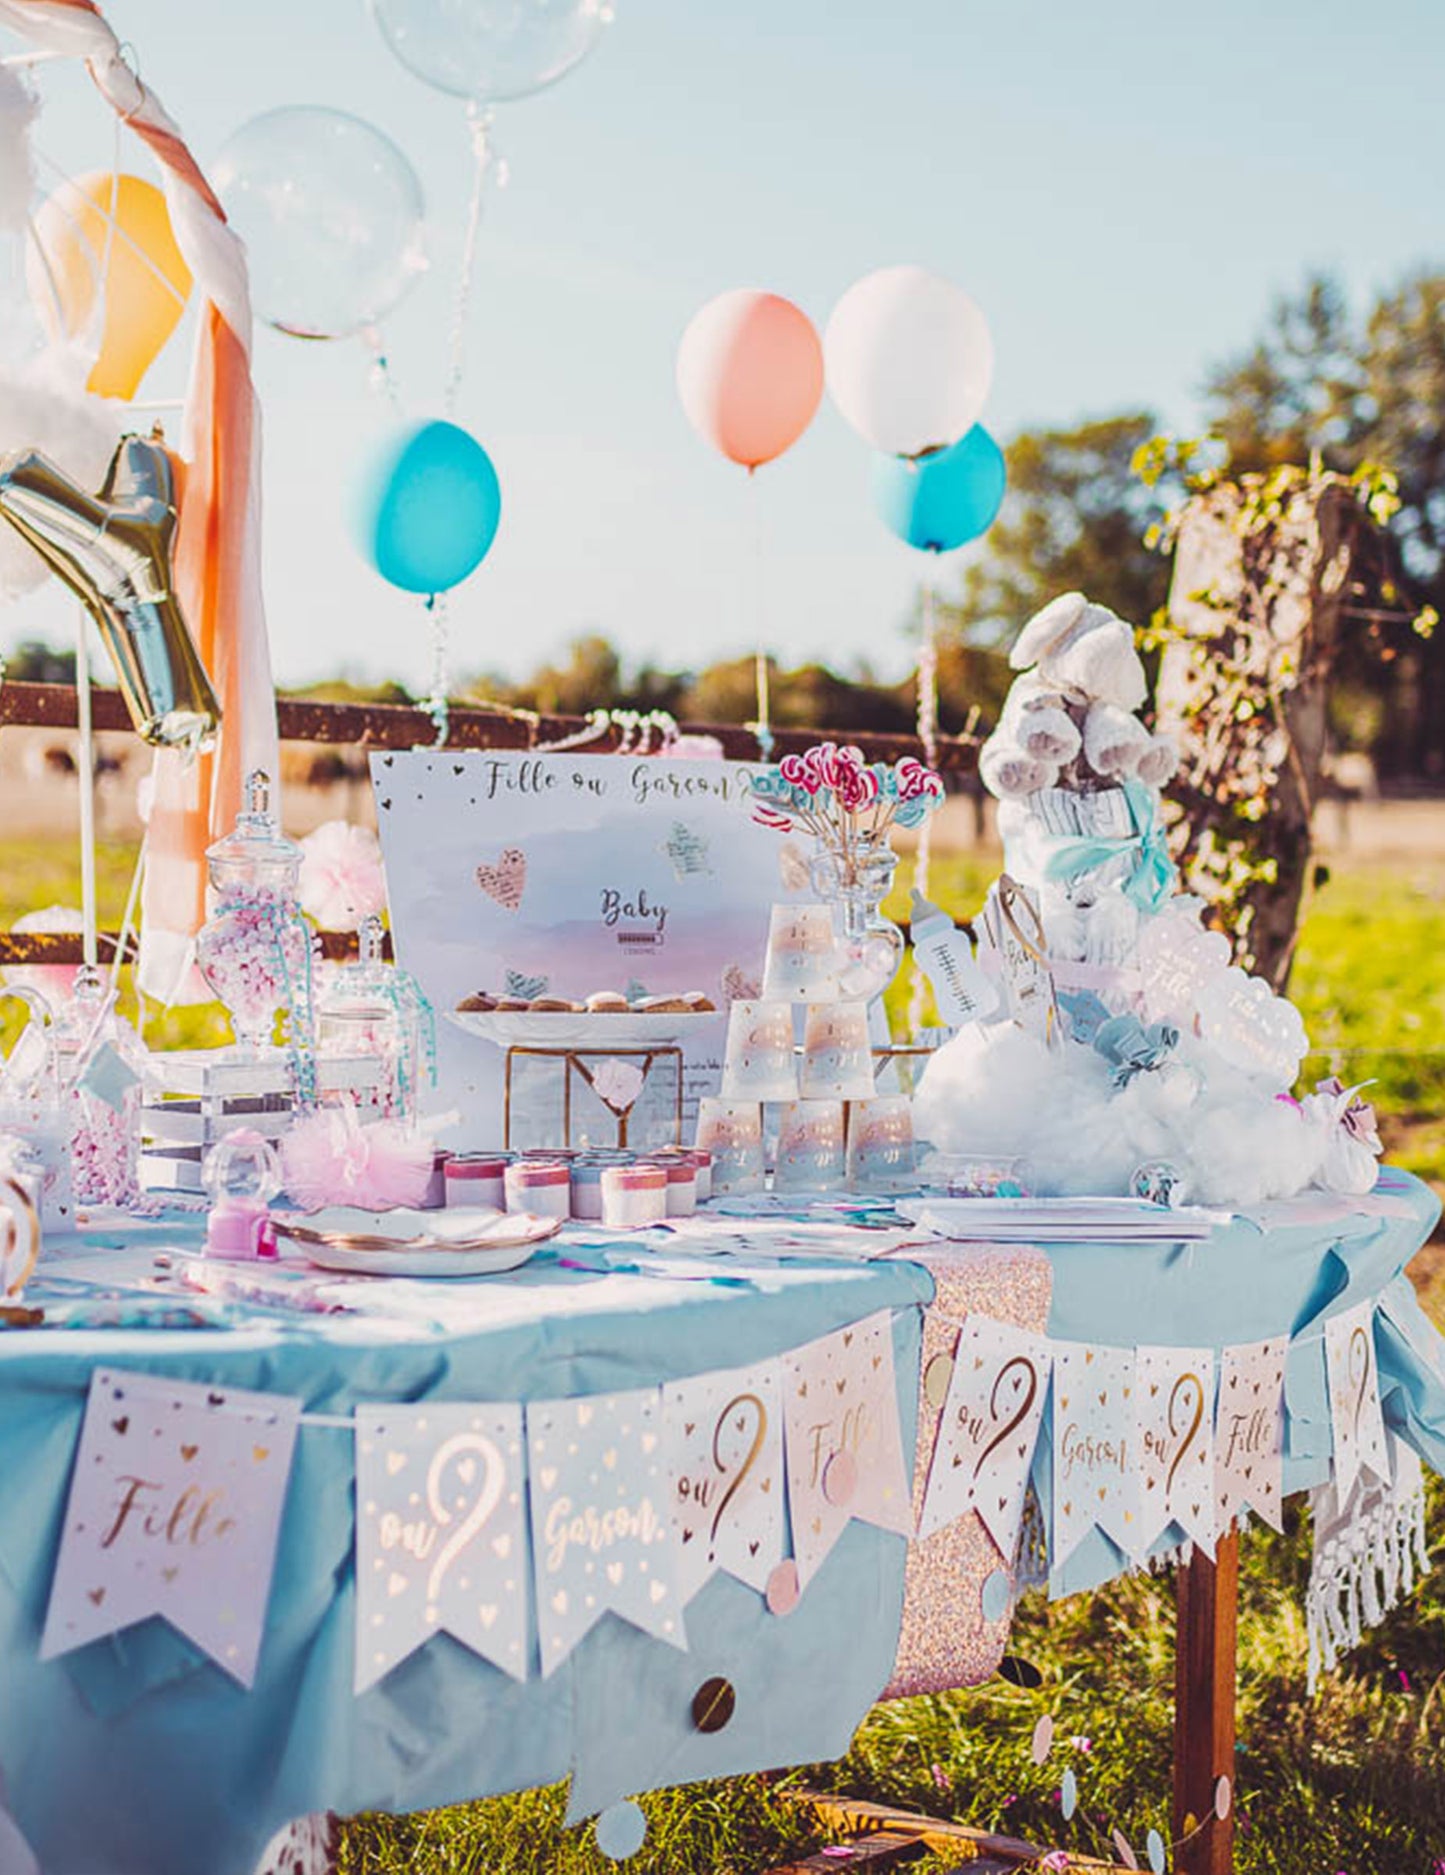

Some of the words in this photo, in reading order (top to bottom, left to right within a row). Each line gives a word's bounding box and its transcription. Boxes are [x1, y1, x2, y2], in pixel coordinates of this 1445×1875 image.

[485, 760, 557, 799] Fille
[571, 772, 603, 796] ou
[600, 888, 669, 932] Baby
[1223, 1407, 1274, 1469] Fille
[101, 1474, 237, 1550] Fille
